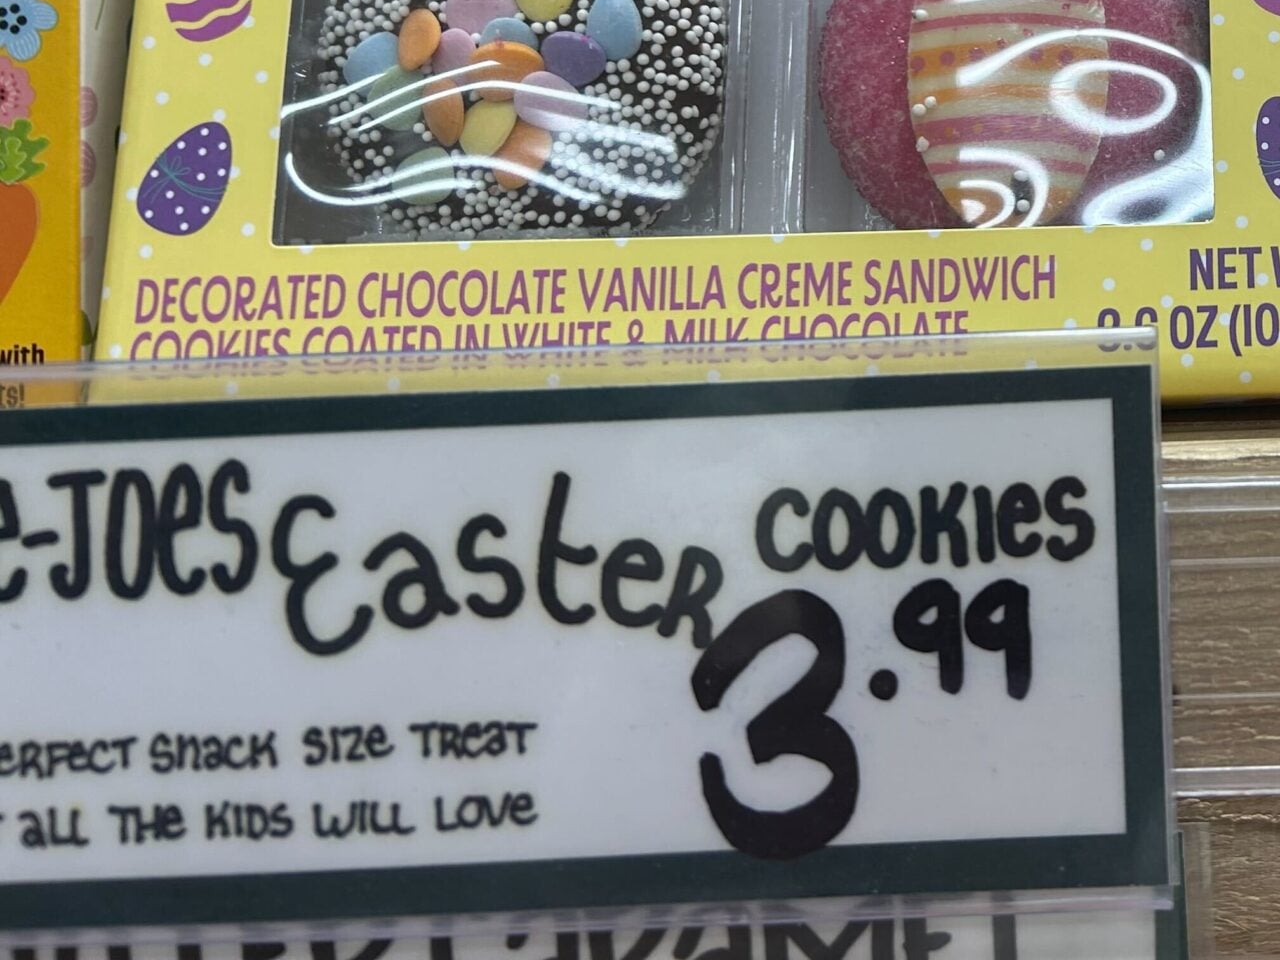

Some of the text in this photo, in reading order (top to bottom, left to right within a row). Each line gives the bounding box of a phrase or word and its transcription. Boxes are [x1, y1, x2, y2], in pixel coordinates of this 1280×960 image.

[134, 254, 1056, 324] DECORATED CHOCOLATE VANILLA CREME SANDWICH
[1189, 246, 1262, 291] NET
[1170, 305, 1219, 350] OZ
[691, 578, 1033, 861] 3.99
[204, 800, 294, 840] KIDS
[312, 800, 417, 839] WILL
